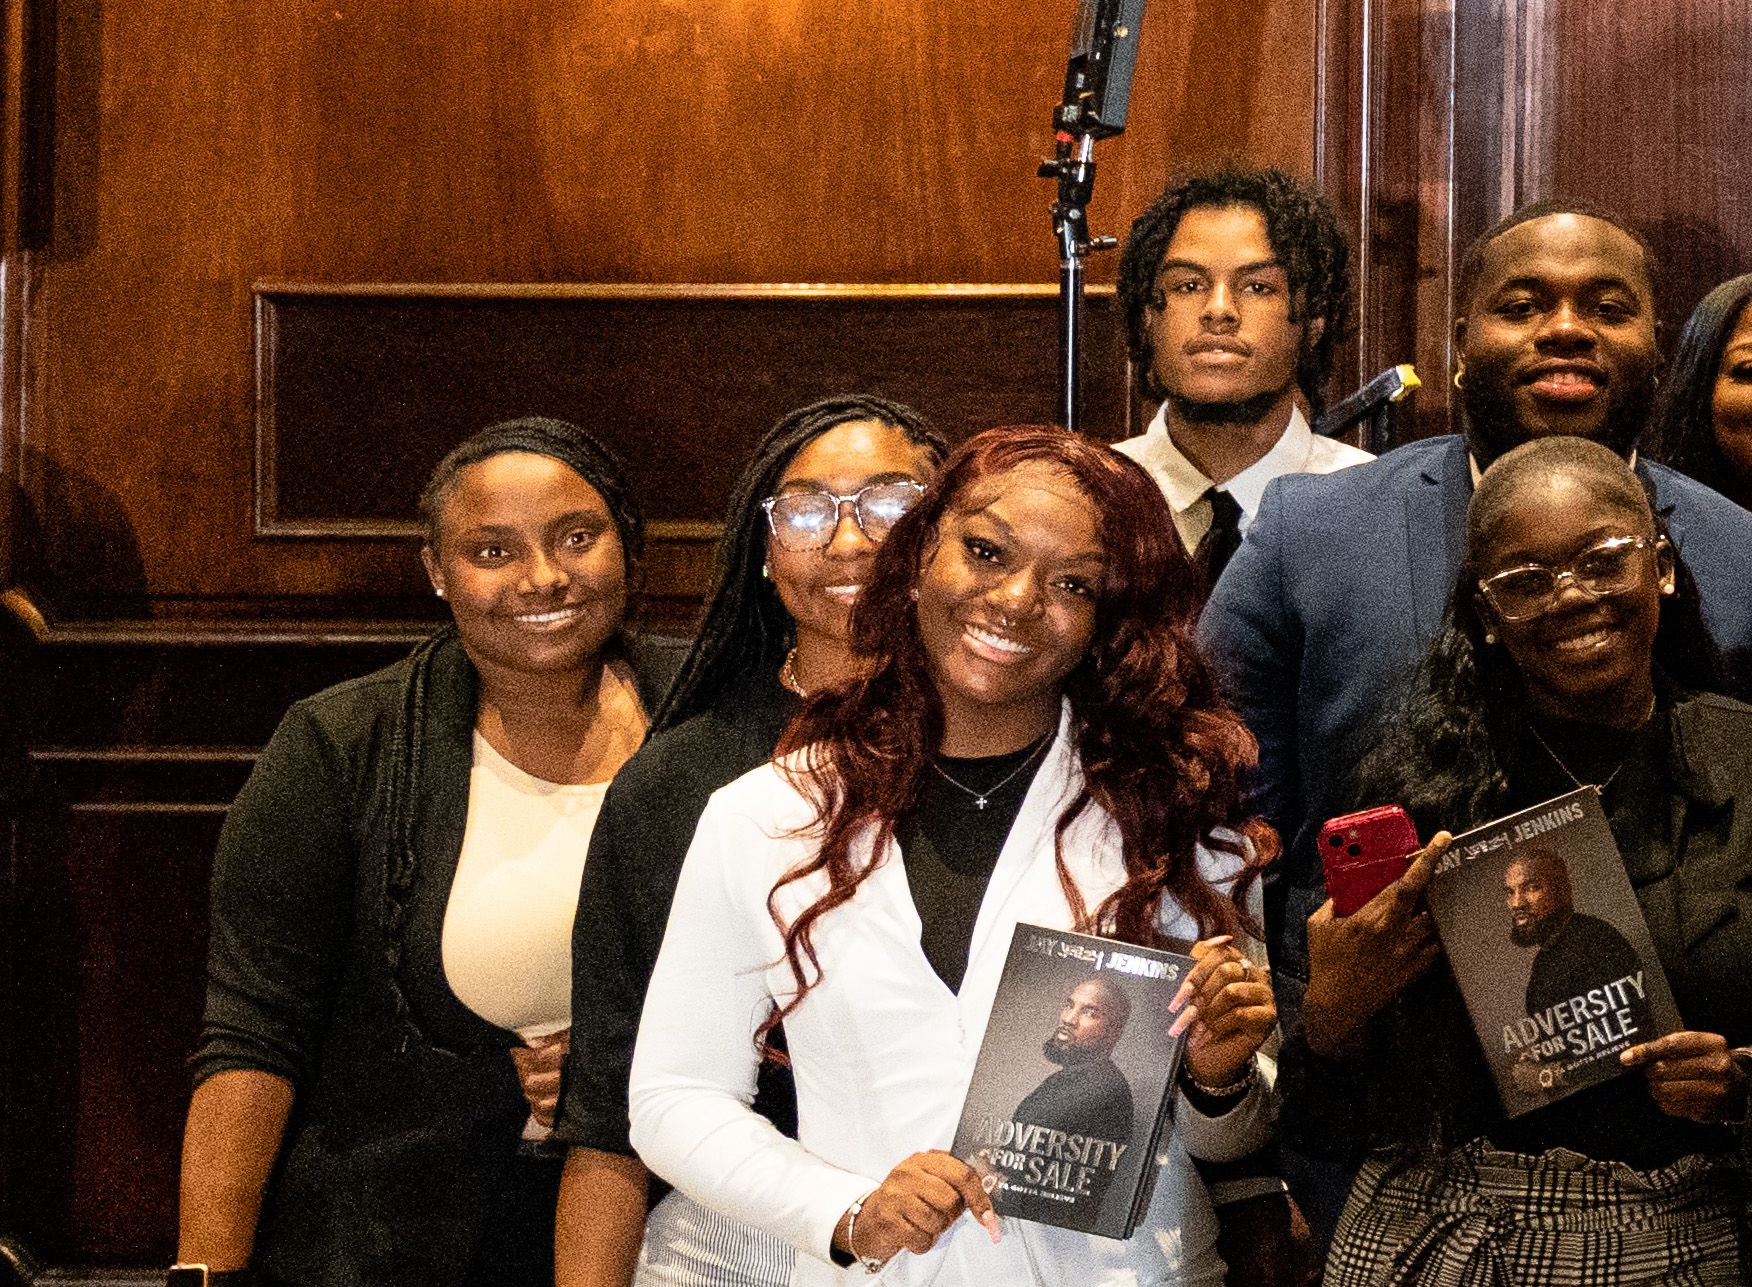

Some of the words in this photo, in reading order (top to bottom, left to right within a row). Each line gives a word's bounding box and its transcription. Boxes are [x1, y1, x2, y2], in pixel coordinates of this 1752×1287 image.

[1513, 802, 1585, 843] JENKINS
[1105, 951, 1180, 982] JENKINS
[1503, 970, 1646, 1054] ADVERSITY
[1531, 1035, 1567, 1062] FOR
[1567, 1007, 1638, 1056] SALE
[973, 1116, 1128, 1171] ADVERSITY
[990, 1148, 1026, 1171] FOR
[1024, 1156, 1096, 1196] SALE
